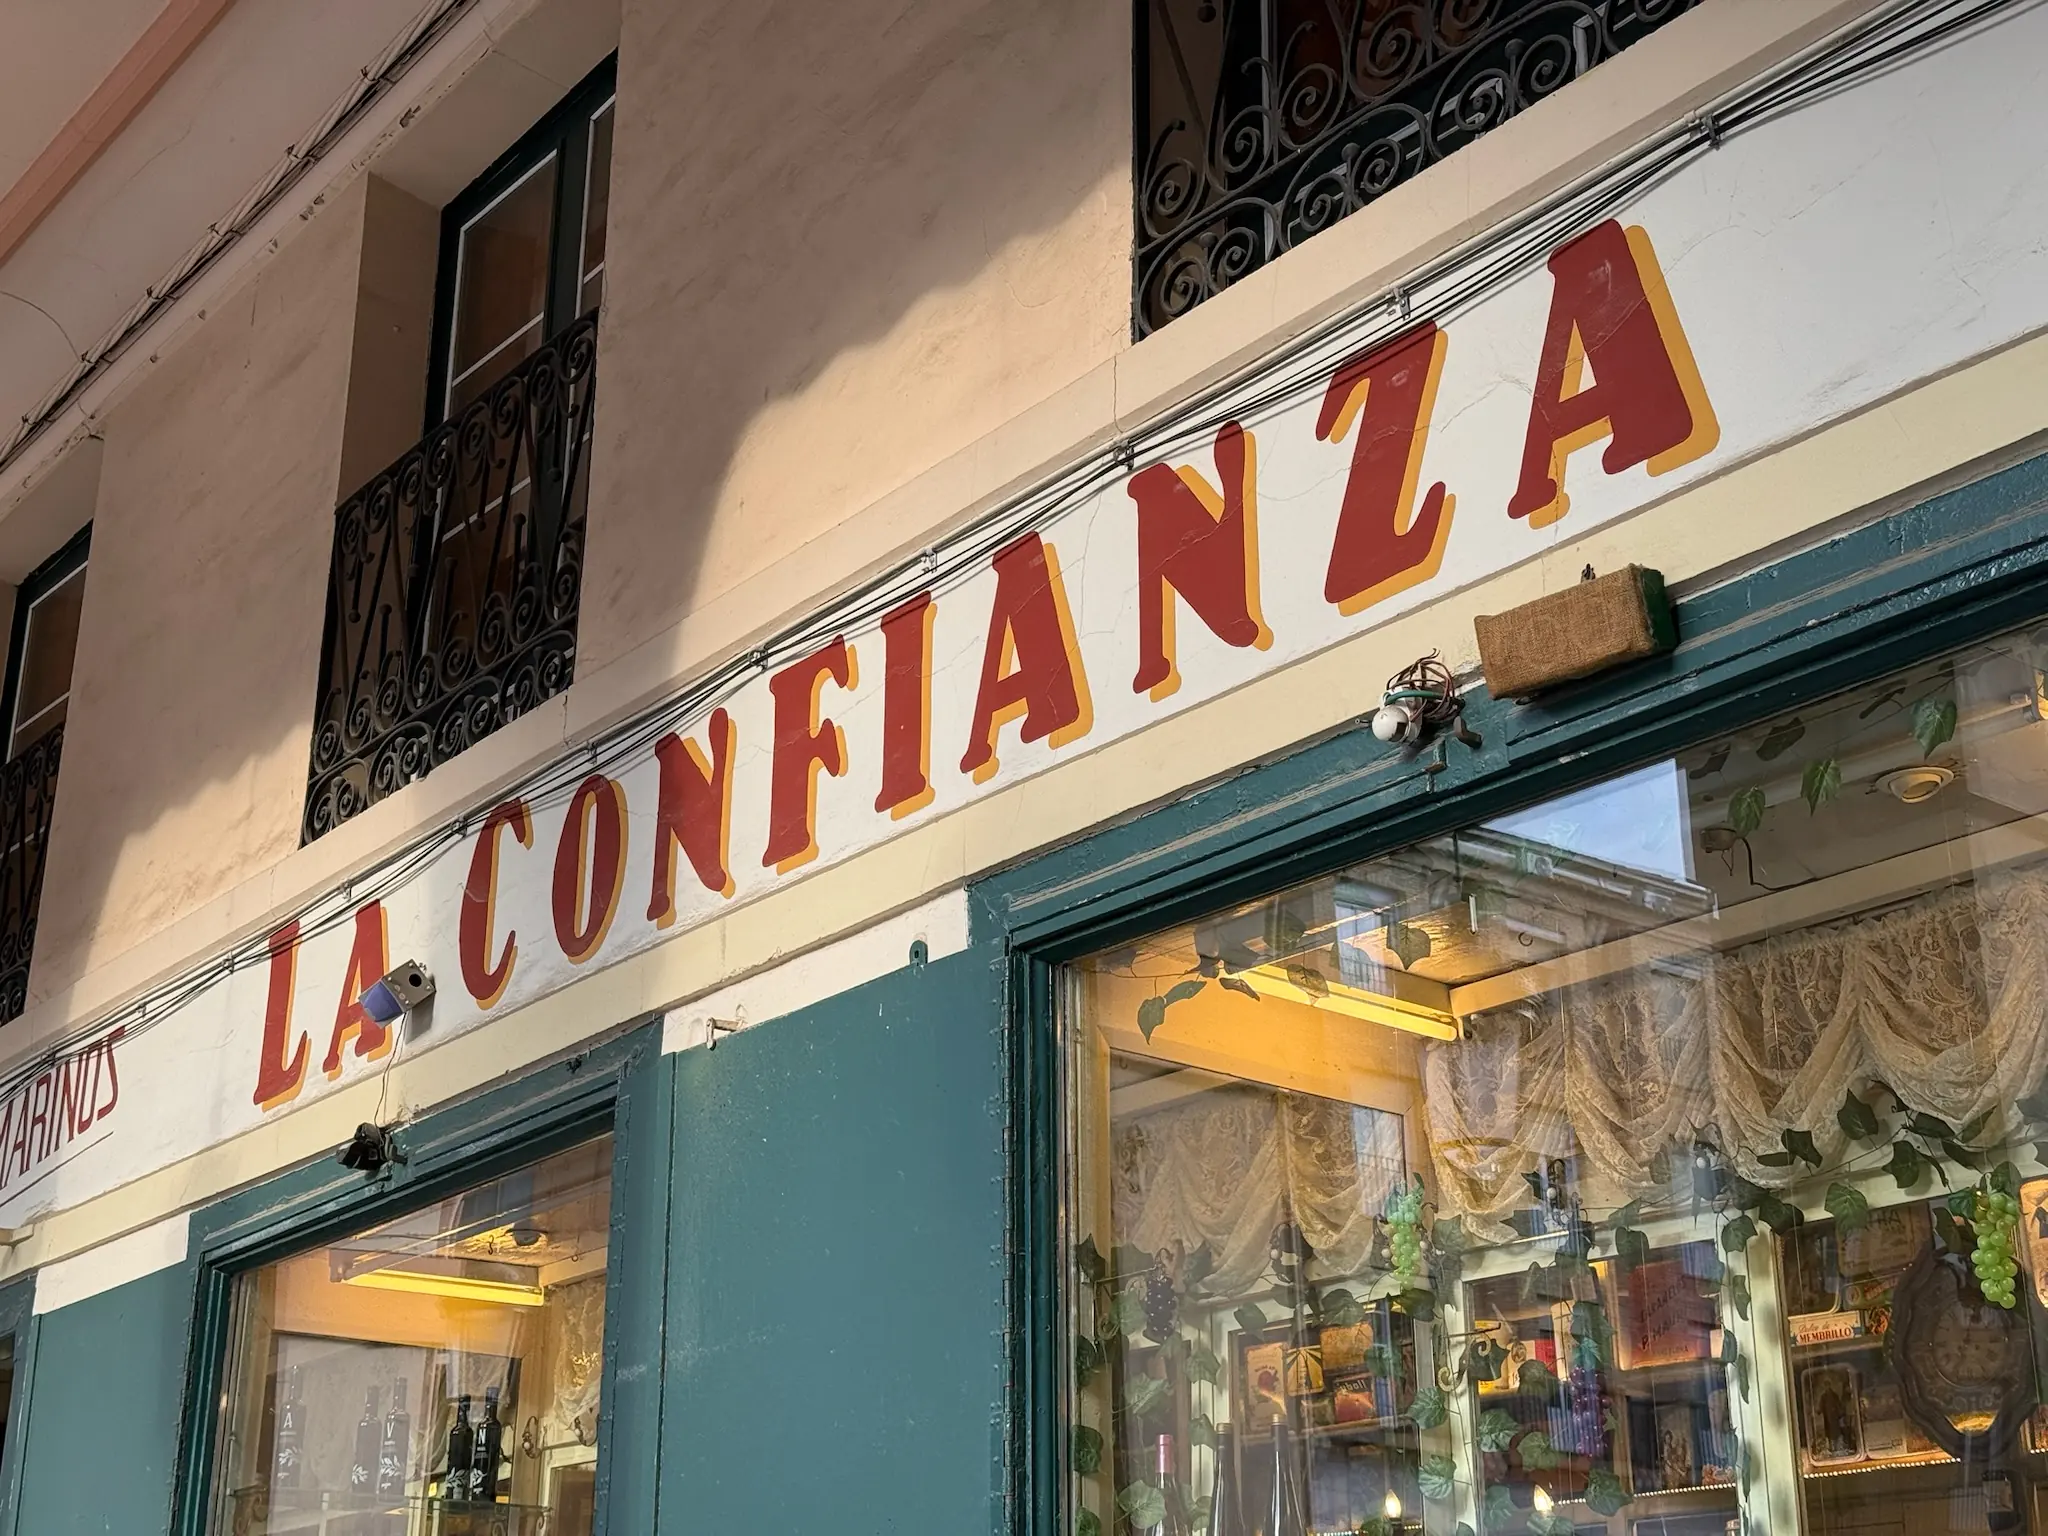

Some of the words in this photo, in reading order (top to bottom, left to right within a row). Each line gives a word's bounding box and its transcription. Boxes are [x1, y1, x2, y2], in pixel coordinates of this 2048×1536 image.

[253, 899, 392, 1113] LA
[459, 218, 1721, 1010] CONFIANZA
[1799, 1326, 1852, 1344] MEMBRILLO
